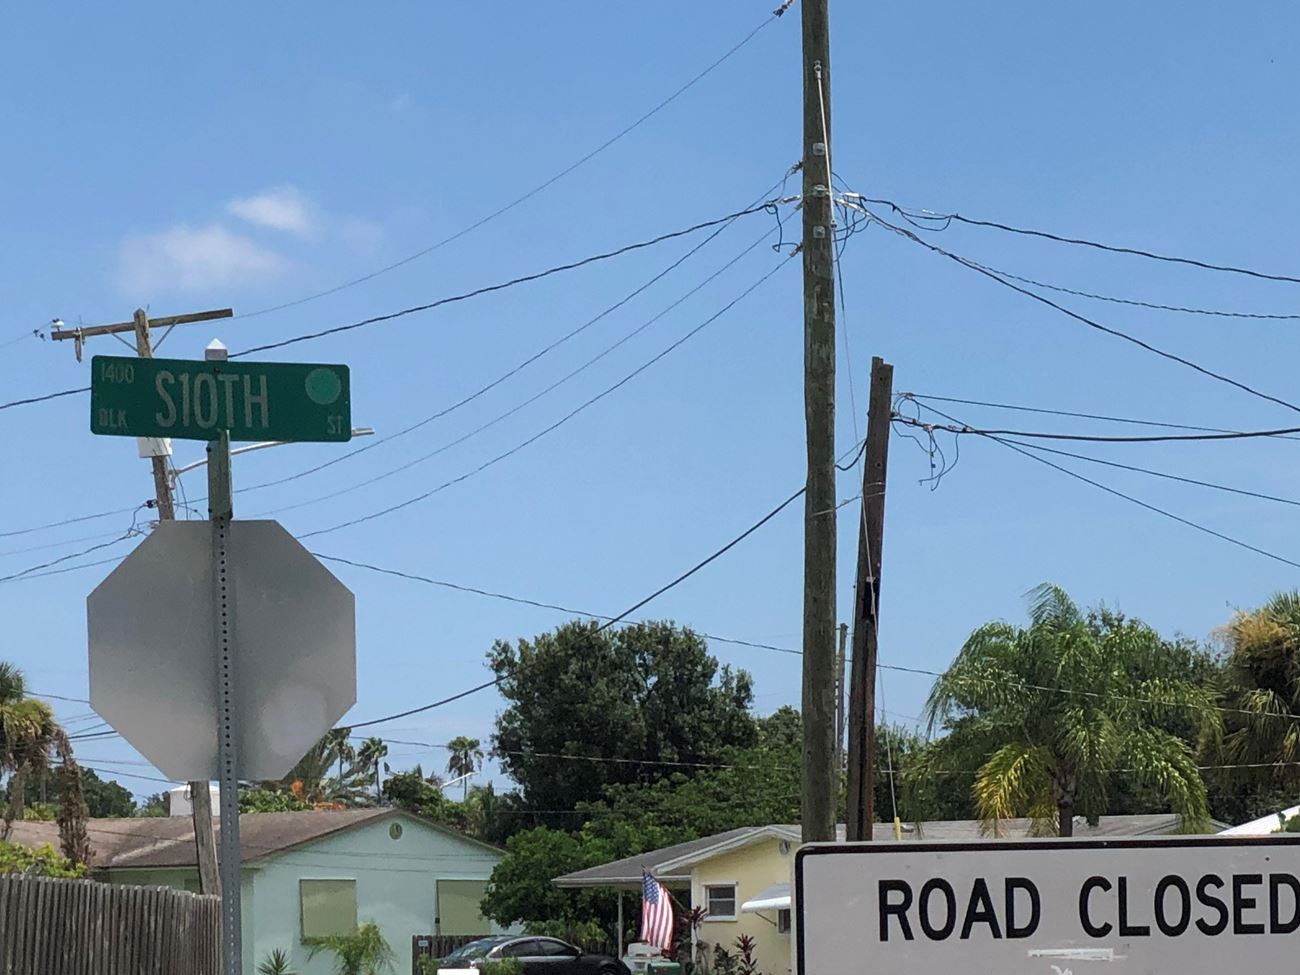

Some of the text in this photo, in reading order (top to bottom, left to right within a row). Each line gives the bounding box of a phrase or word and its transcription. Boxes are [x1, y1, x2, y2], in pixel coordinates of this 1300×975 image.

[101, 362, 135, 384] 1400
[98, 407, 129, 429] BLK
[327, 415, 344, 434] ST
[878, 877, 1041, 942] ROAD
